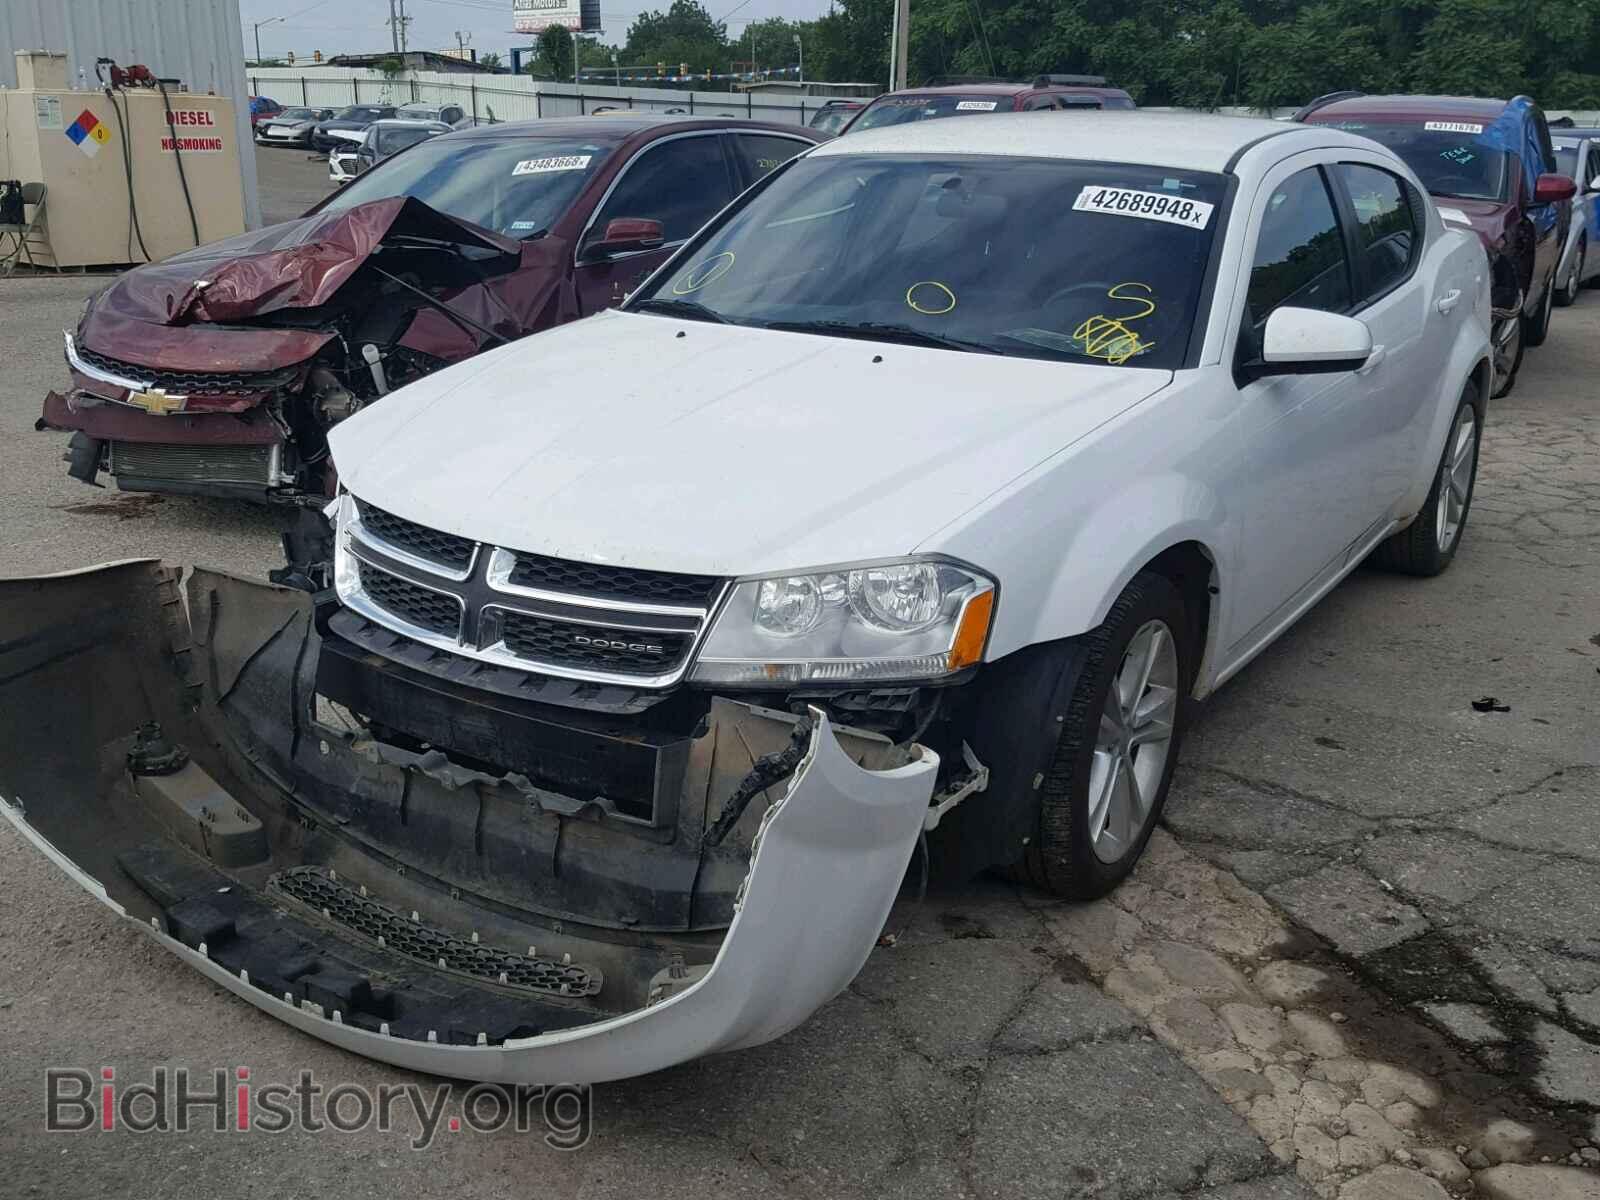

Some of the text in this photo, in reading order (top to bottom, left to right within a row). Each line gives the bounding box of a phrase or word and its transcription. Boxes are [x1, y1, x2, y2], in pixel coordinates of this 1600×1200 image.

[165, 111, 213, 125] DIESEL
[161, 138, 222, 150] NO SMOKING
[575, 636, 663, 654] DODGE
